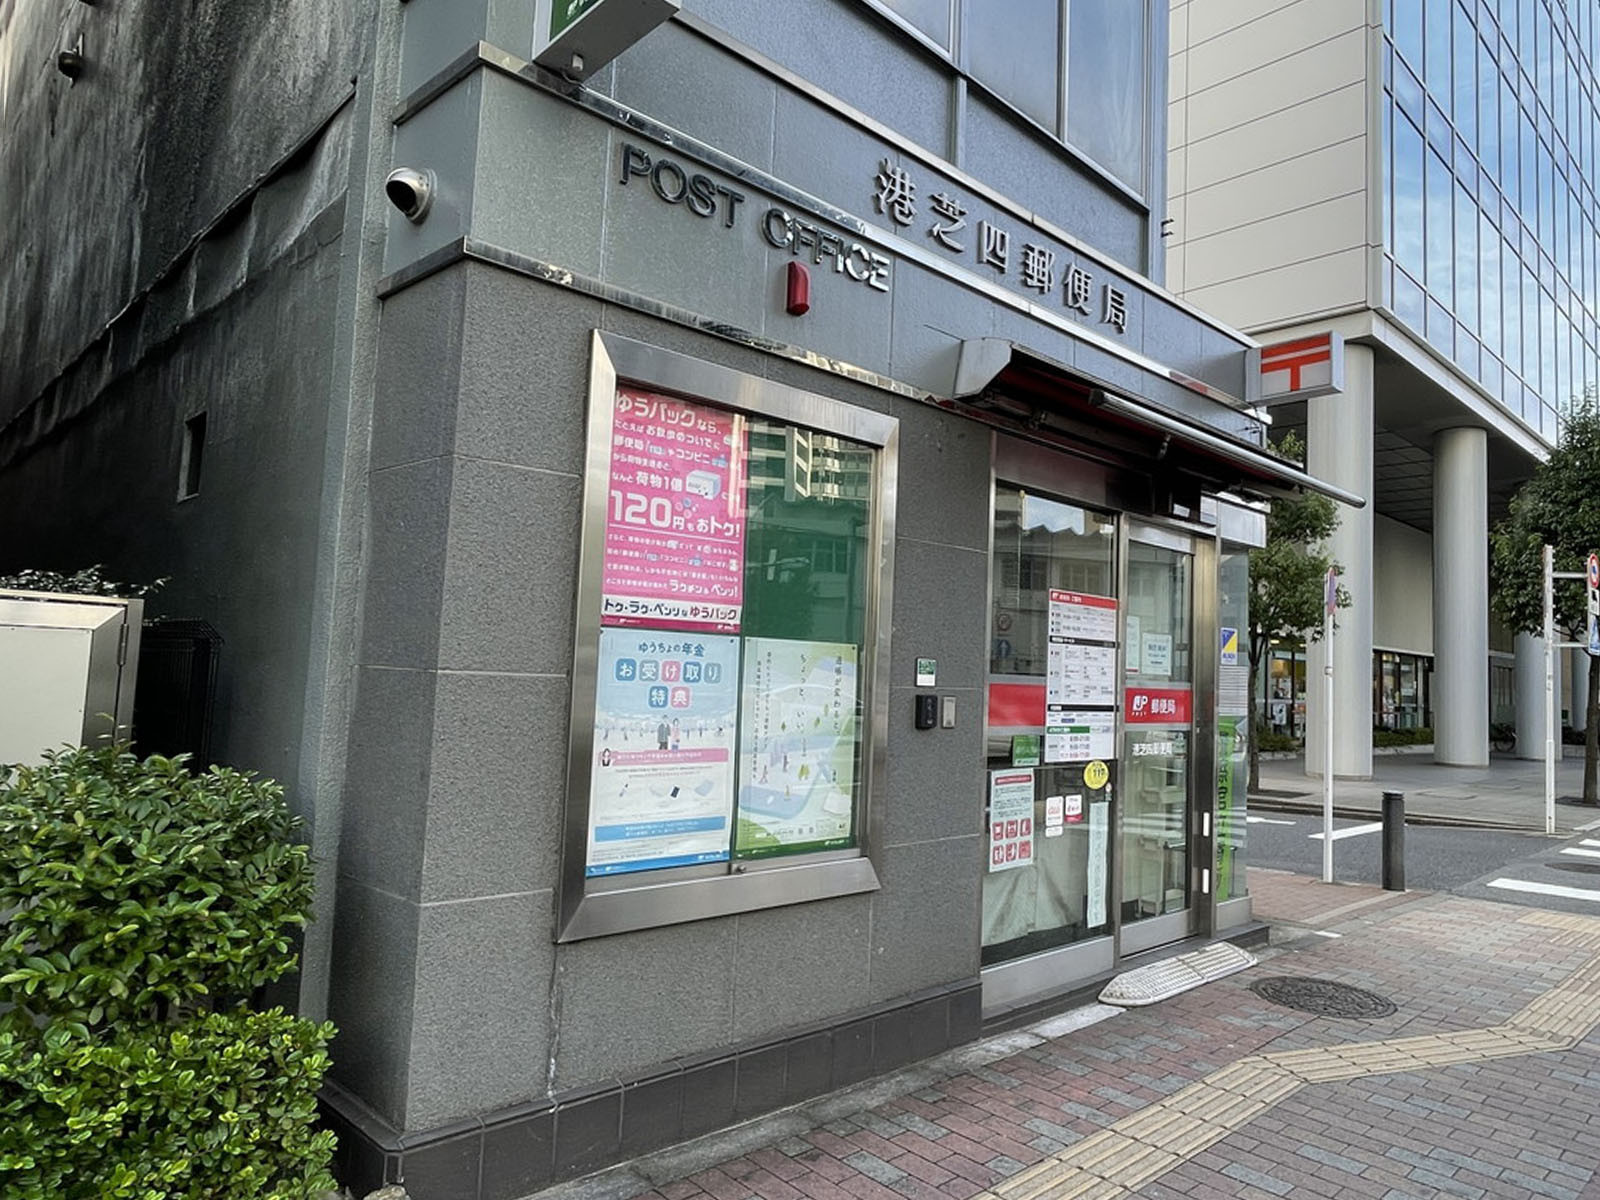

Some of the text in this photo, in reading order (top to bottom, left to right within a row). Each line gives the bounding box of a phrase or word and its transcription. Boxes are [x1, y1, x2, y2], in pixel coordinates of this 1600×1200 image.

[619, 142, 891, 293] POST OFFICE
[874, 157, 1129, 334] 港芝四郵便局
[639, 641, 705, 657] ゆうちょの年金
[617, 661, 720, 683] お受け取り
[650, 687, 688, 707] 特典
[1151, 698, 1176, 715] 郵便局
